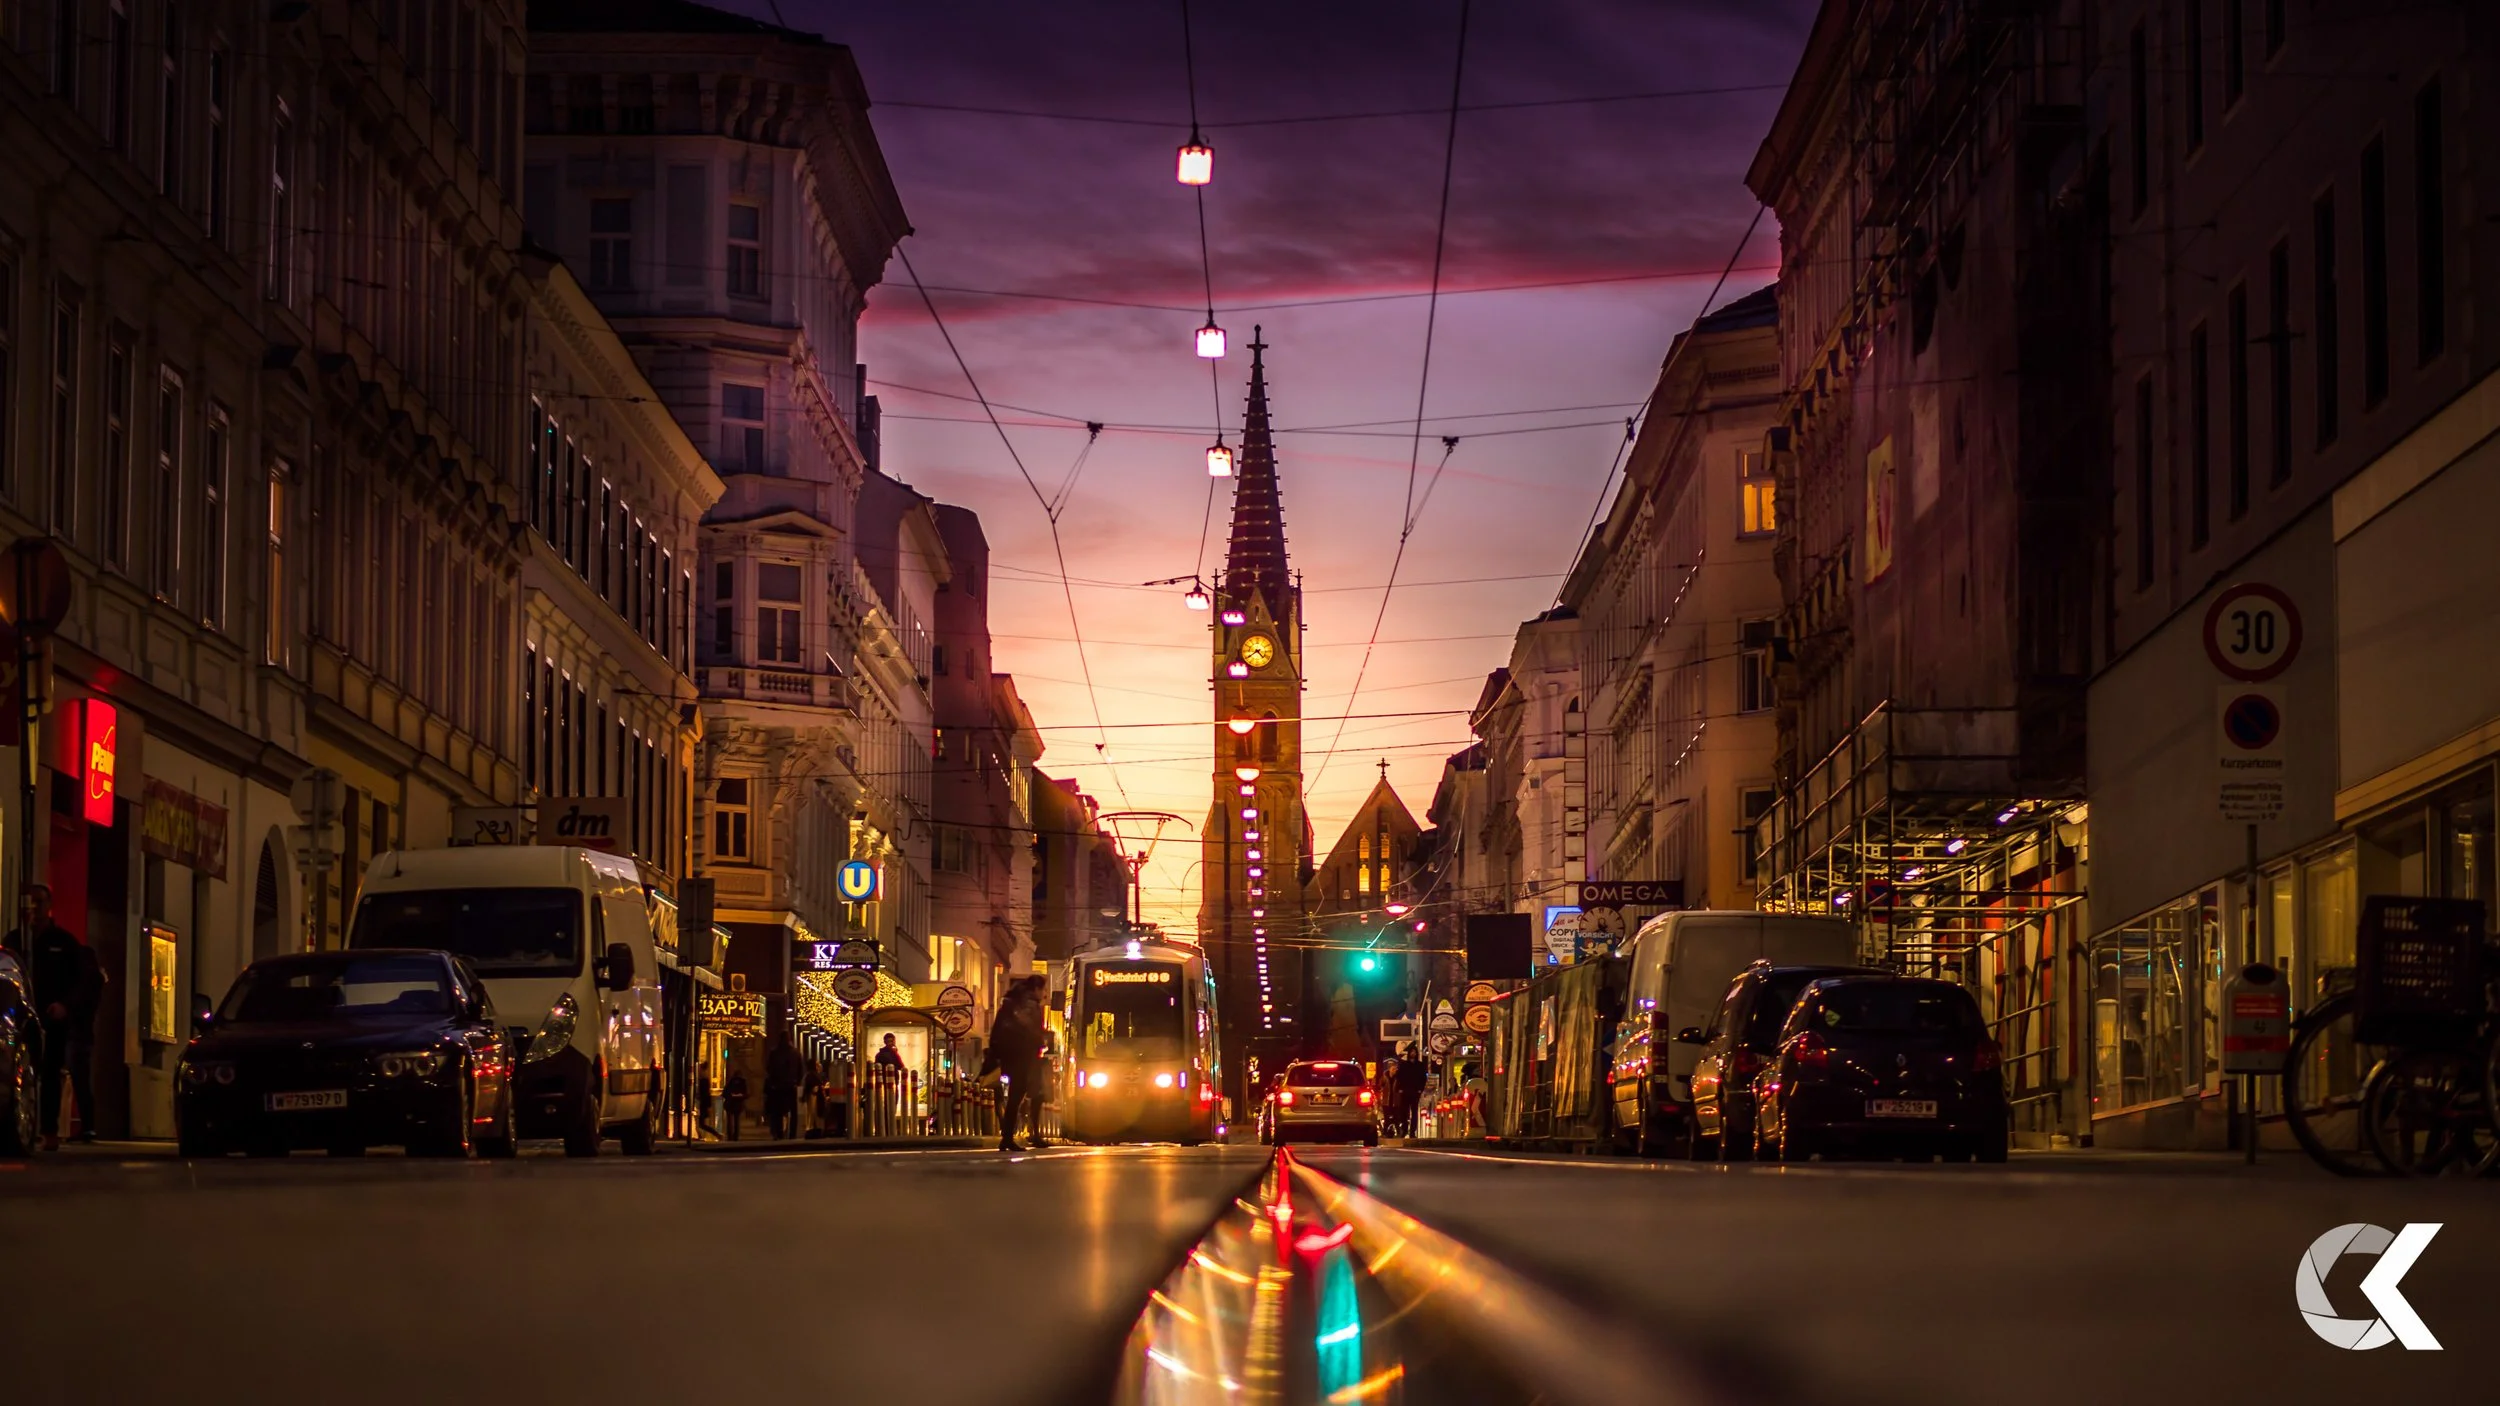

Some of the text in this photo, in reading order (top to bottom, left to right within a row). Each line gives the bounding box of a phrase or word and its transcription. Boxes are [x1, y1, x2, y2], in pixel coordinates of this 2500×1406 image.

[2231, 610, 2274, 654] 30
[558, 805, 610, 837] dm
[844, 867, 871, 897] U
[1584, 885, 1668, 901] OMEGA
[1095, 969, 1104, 986] 9
[276, 1096, 284, 1107] W
[294, 1092, 331, 1106] 79197
